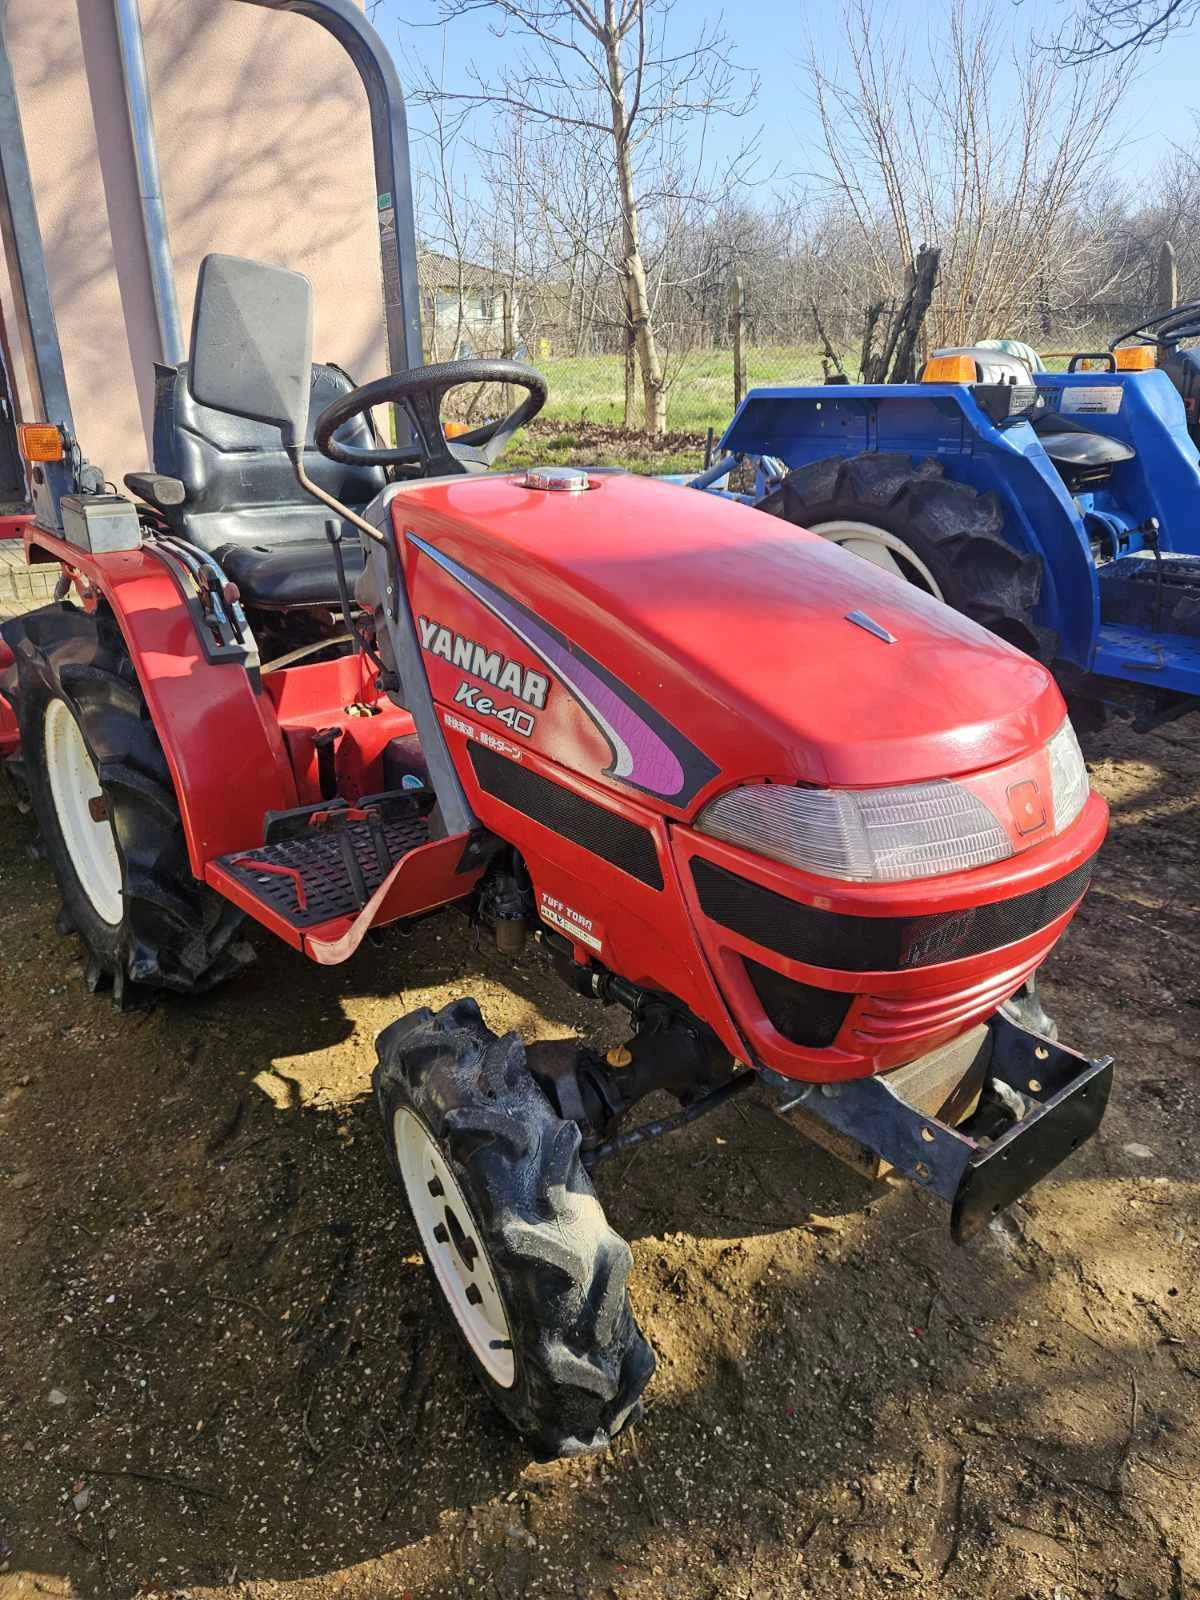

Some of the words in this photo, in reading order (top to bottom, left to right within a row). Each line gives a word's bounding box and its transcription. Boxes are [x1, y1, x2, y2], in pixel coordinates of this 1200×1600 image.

[418, 615, 551, 710] YANMAR
[454, 682, 535, 737] Ke-40
[542, 893, 564, 911] TUFF
